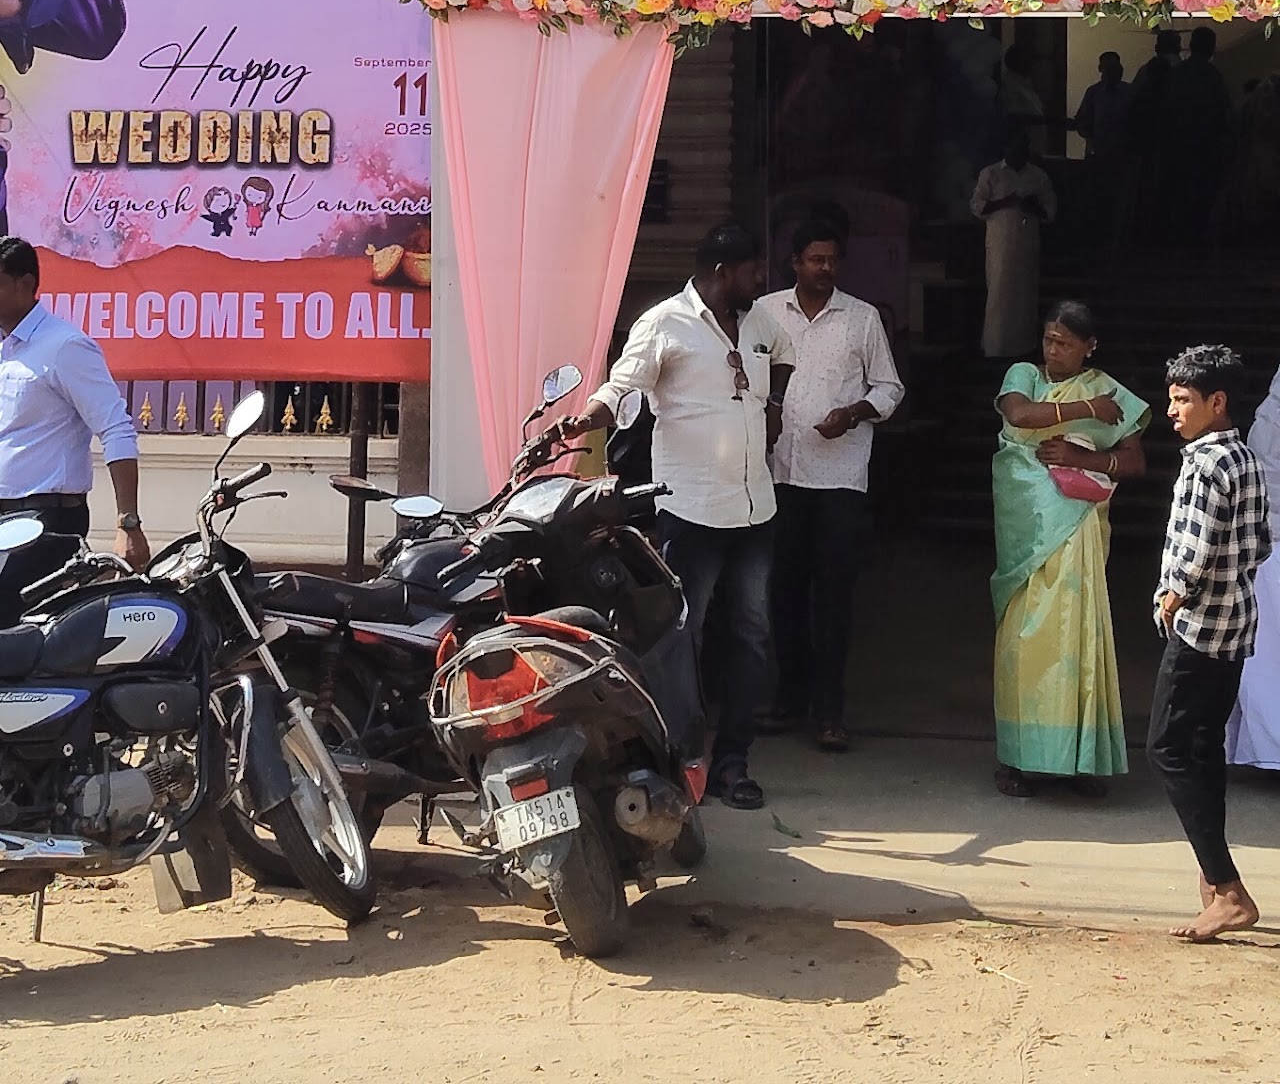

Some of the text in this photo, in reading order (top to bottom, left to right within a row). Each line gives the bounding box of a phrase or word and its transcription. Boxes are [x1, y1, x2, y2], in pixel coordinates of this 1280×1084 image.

[139, 26, 311, 107] Happy
[354, 57, 432, 69] September
[393, 71, 428, 117] 11
[70, 110, 333, 165] WEDDING
[384, 122, 432, 136] 2025
[64, 174, 433, 227] Vignesh Kanmani
[40, 292, 432, 340] WELCOME TO ALL.
